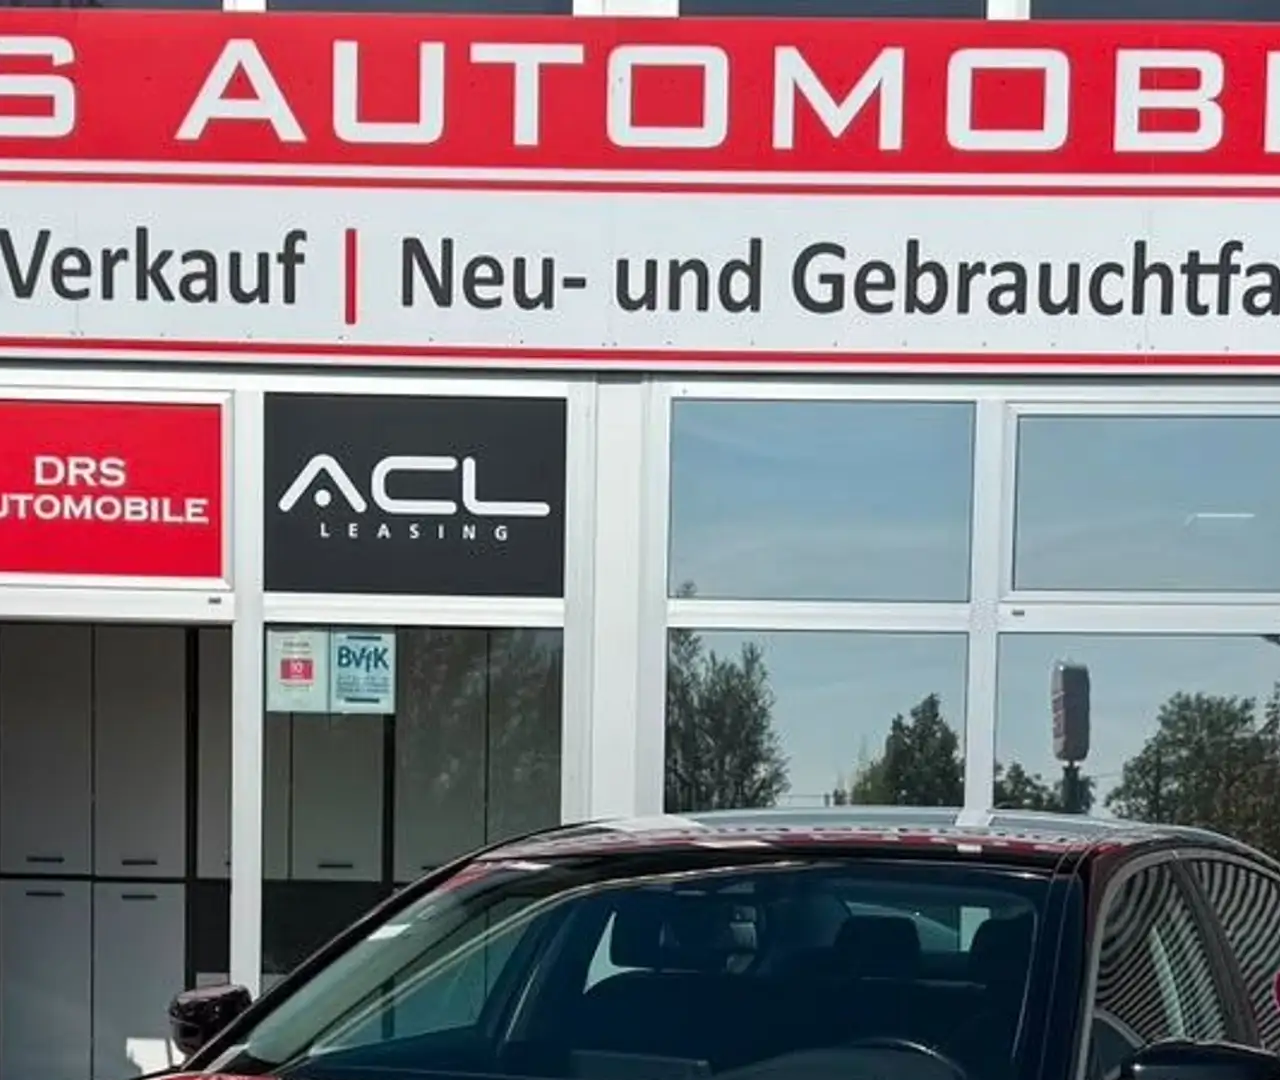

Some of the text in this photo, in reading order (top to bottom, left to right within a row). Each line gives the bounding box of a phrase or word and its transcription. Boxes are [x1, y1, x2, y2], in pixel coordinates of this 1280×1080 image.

[402, 237, 587, 311] Neu-
[616, 238, 762, 313] und
[34, 455, 127, 488] DRS
[277, 453, 551, 517] ACL
[320, 521, 508, 541] LEASING
